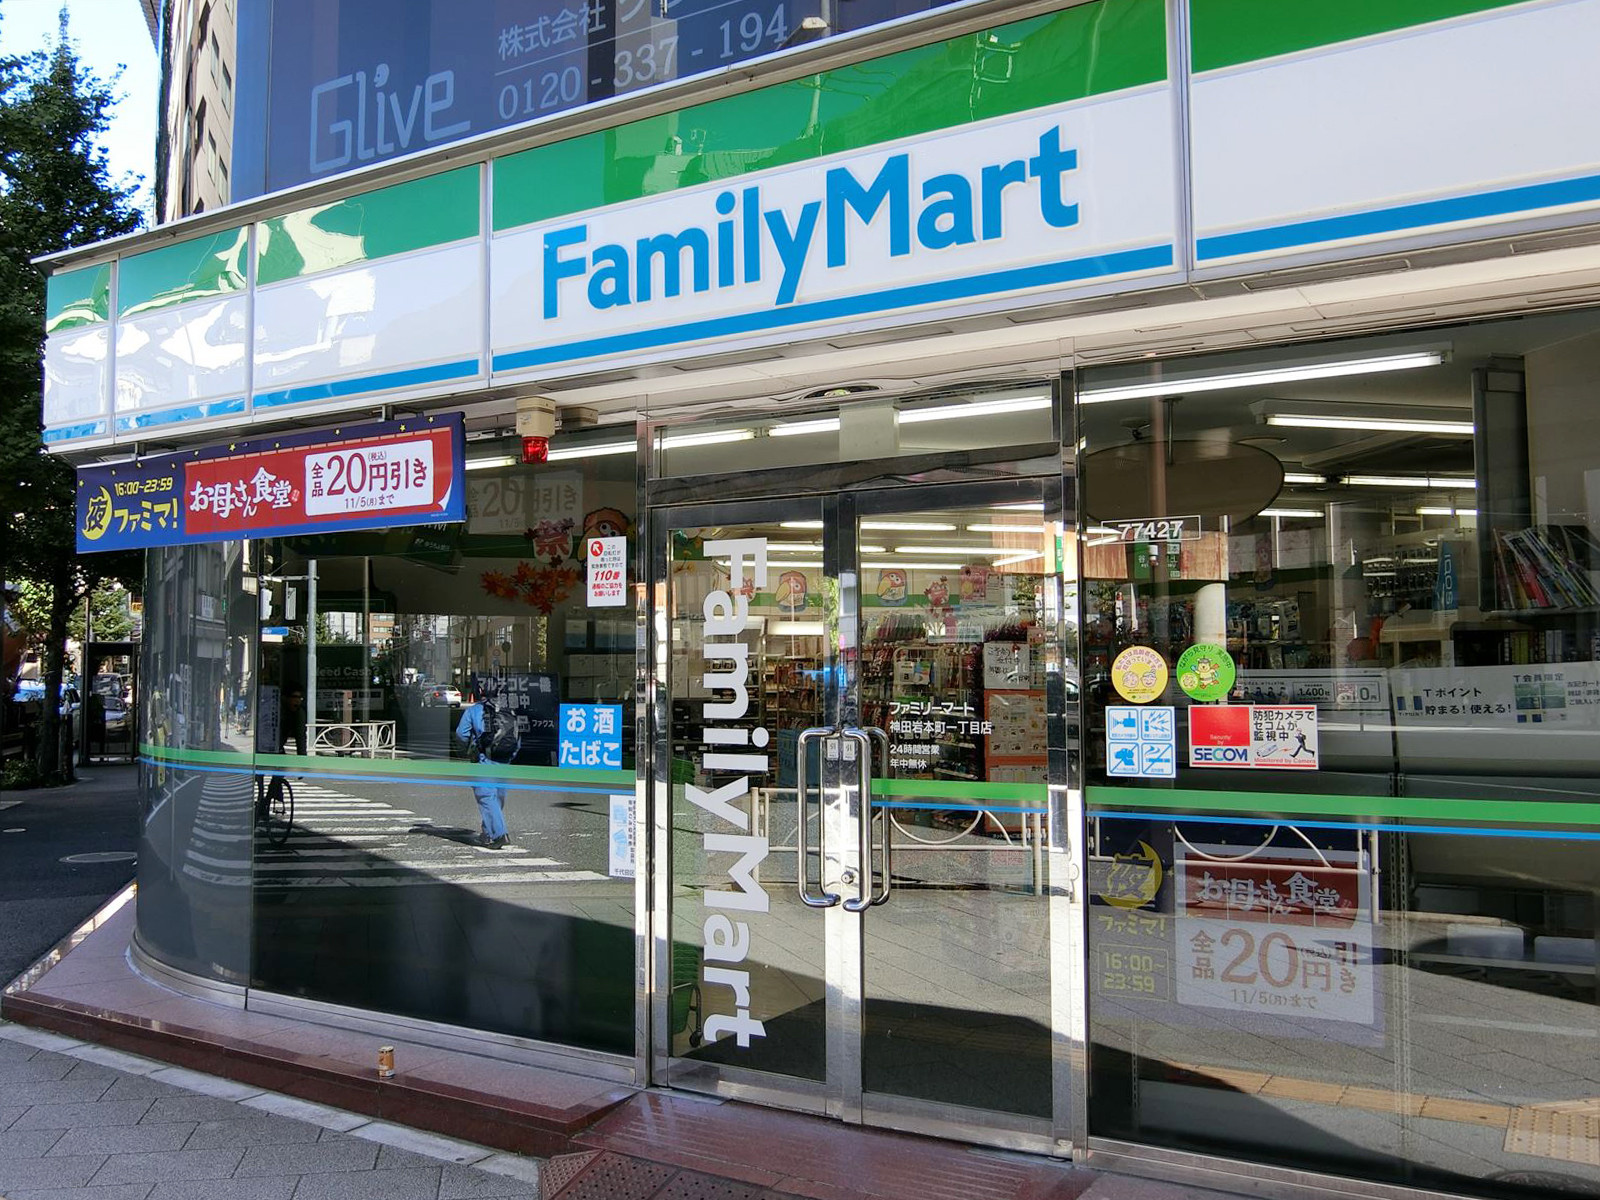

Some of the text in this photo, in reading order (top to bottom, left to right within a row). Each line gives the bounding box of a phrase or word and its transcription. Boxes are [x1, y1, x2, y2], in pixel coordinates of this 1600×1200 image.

[498, 0, 606, 61] 株式会社
[543, 124, 1079, 320] FamilyMart
[189, 466, 292, 519] お母さん食堂
[1117, 520, 1184, 541] 77427
[594, 569, 621, 581] 110番
[889, 701, 975, 717] ファミリーマート
[1253, 710, 1315, 721] 防犯カメラで
[566, 707, 615, 735] お酒
[889, 720, 993, 735] 神田岩本町一丁目店
[1253, 720, 1298, 731] セコムが
[1253, 730, 1289, 742] 監視中
[560, 739, 621, 767] たばこ
[889, 744, 940, 755] 24時間営業
[1194, 747, 1248, 762] SECOM
[889, 758, 927, 770] 年中無休
[685, 537, 769, 1048] FamilyMart
[1195, 871, 1341, 917] お母さん食堂
[1103, 972, 1156, 993] 23:59
